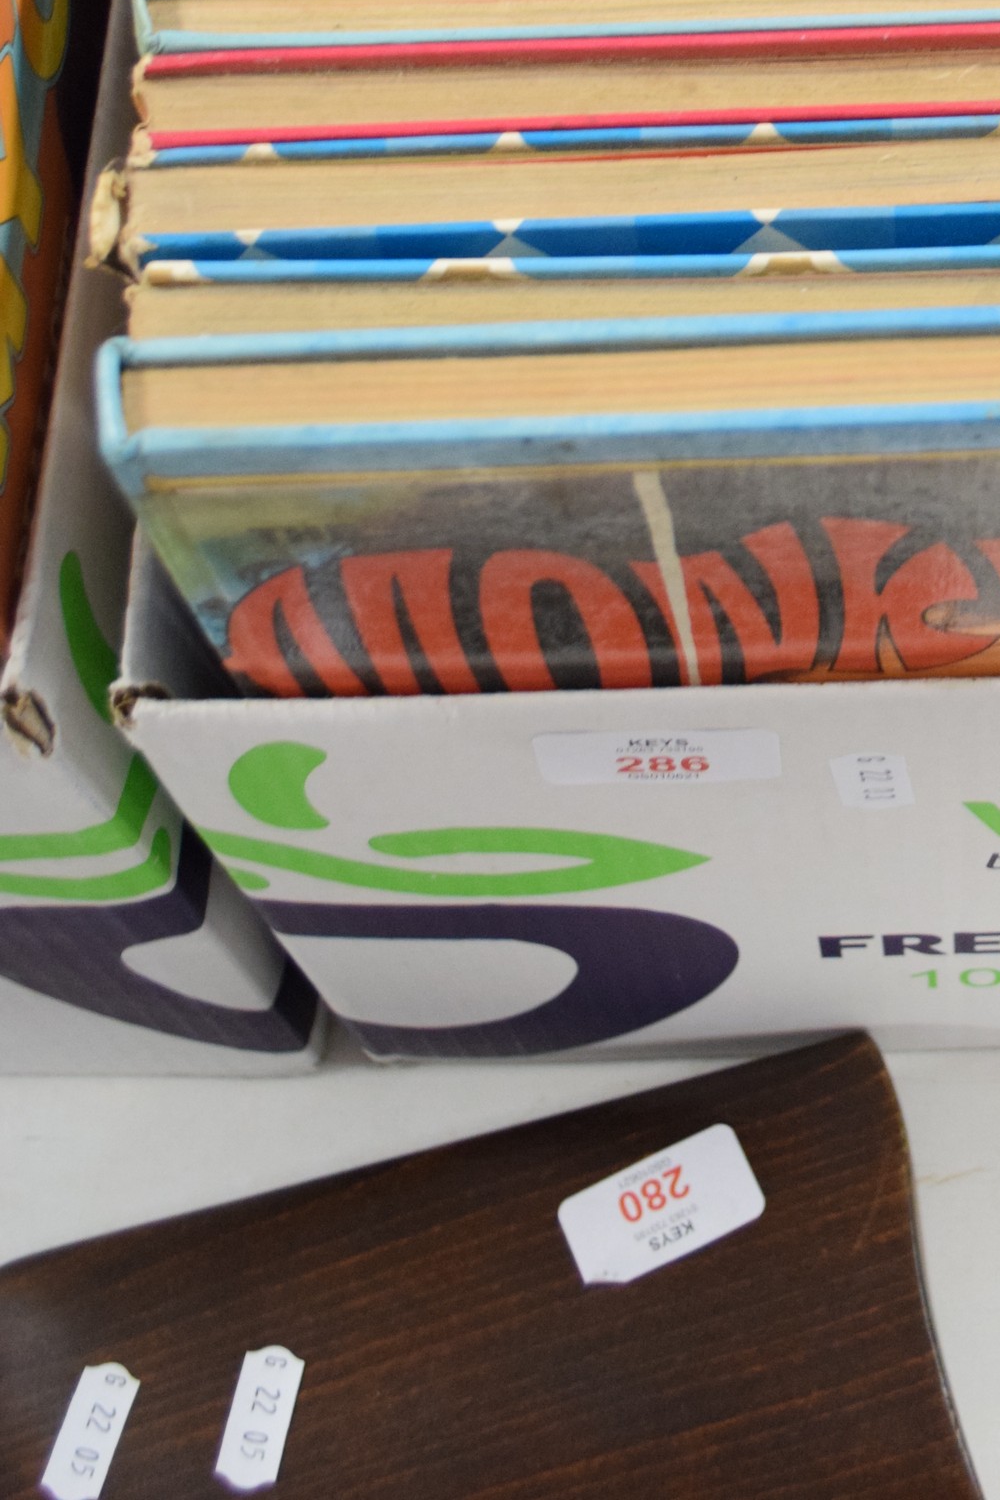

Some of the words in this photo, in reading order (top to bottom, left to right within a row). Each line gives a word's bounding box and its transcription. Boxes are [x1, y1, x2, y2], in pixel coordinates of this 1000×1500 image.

[628, 738, 689, 747] KEYS
[615, 755, 710, 773] 286
[618, 1163, 690, 1223] 280
[648, 1220, 695, 1251] KEYS
[251, 1385, 281, 1415] 22
[86, 1401, 117, 1434] 22
[240, 1430, 269, 1462] 05
[71, 1446, 100, 1480] 05
